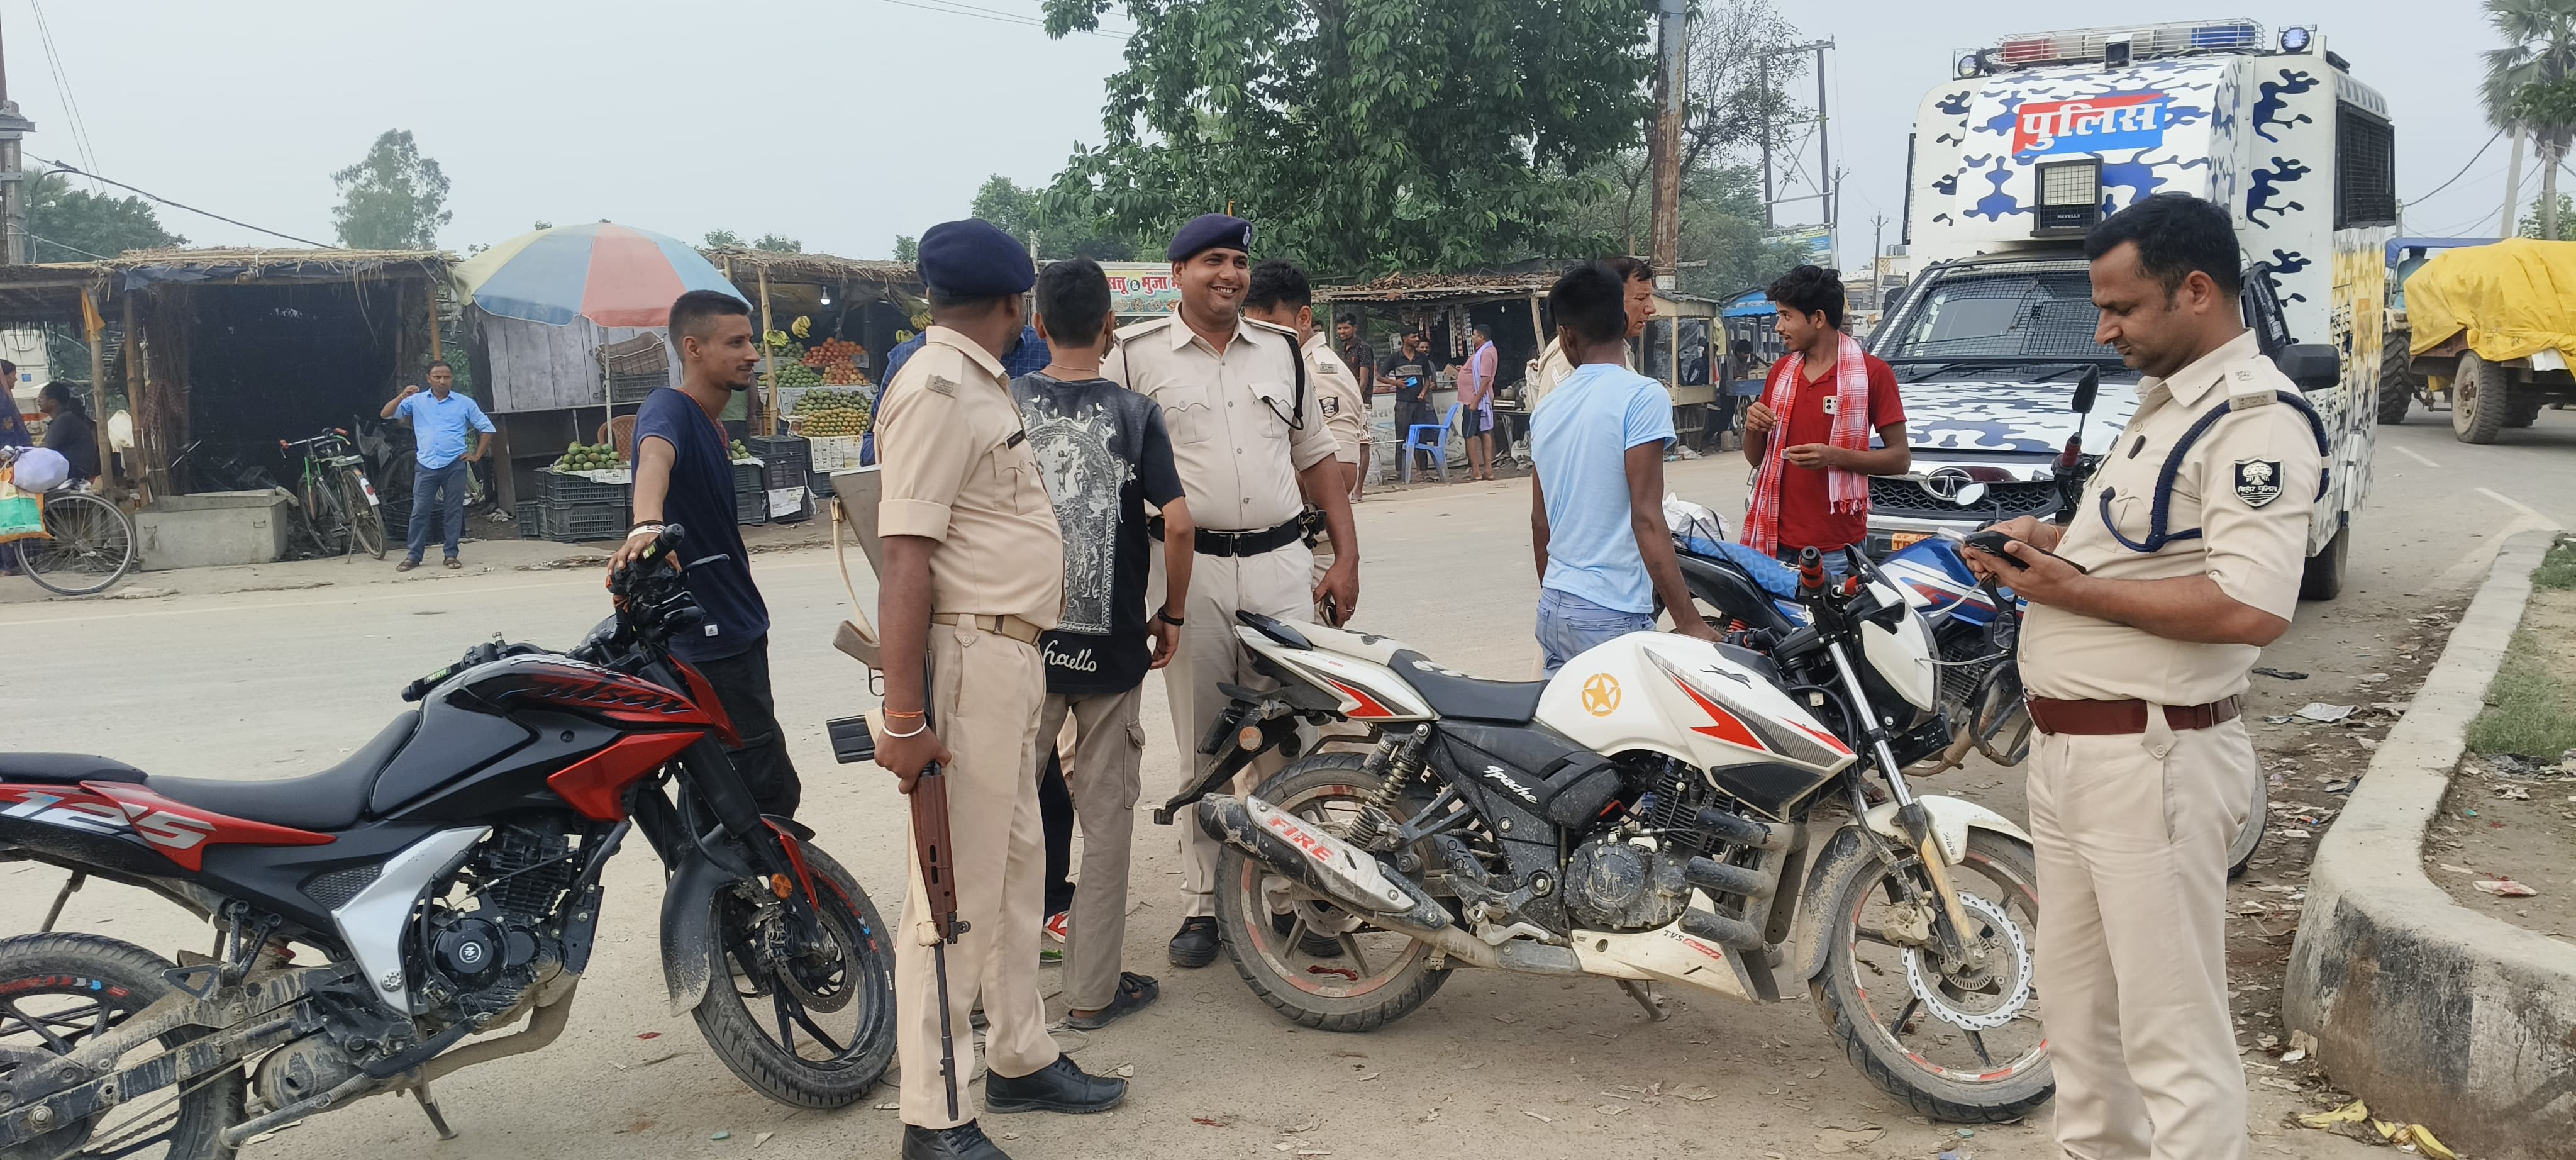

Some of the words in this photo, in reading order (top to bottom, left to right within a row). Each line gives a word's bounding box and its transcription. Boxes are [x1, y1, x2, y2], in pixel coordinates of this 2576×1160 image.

[2022, 103, 2163, 152] पुलिस
[1141, 277, 1169, 294] भुजा
[1483, 764, 1540, 805] Apache
[0, 791, 218, 849] 125
[1267, 816, 1335, 861] FIRE
[1663, 930, 1685, 942] TVS
